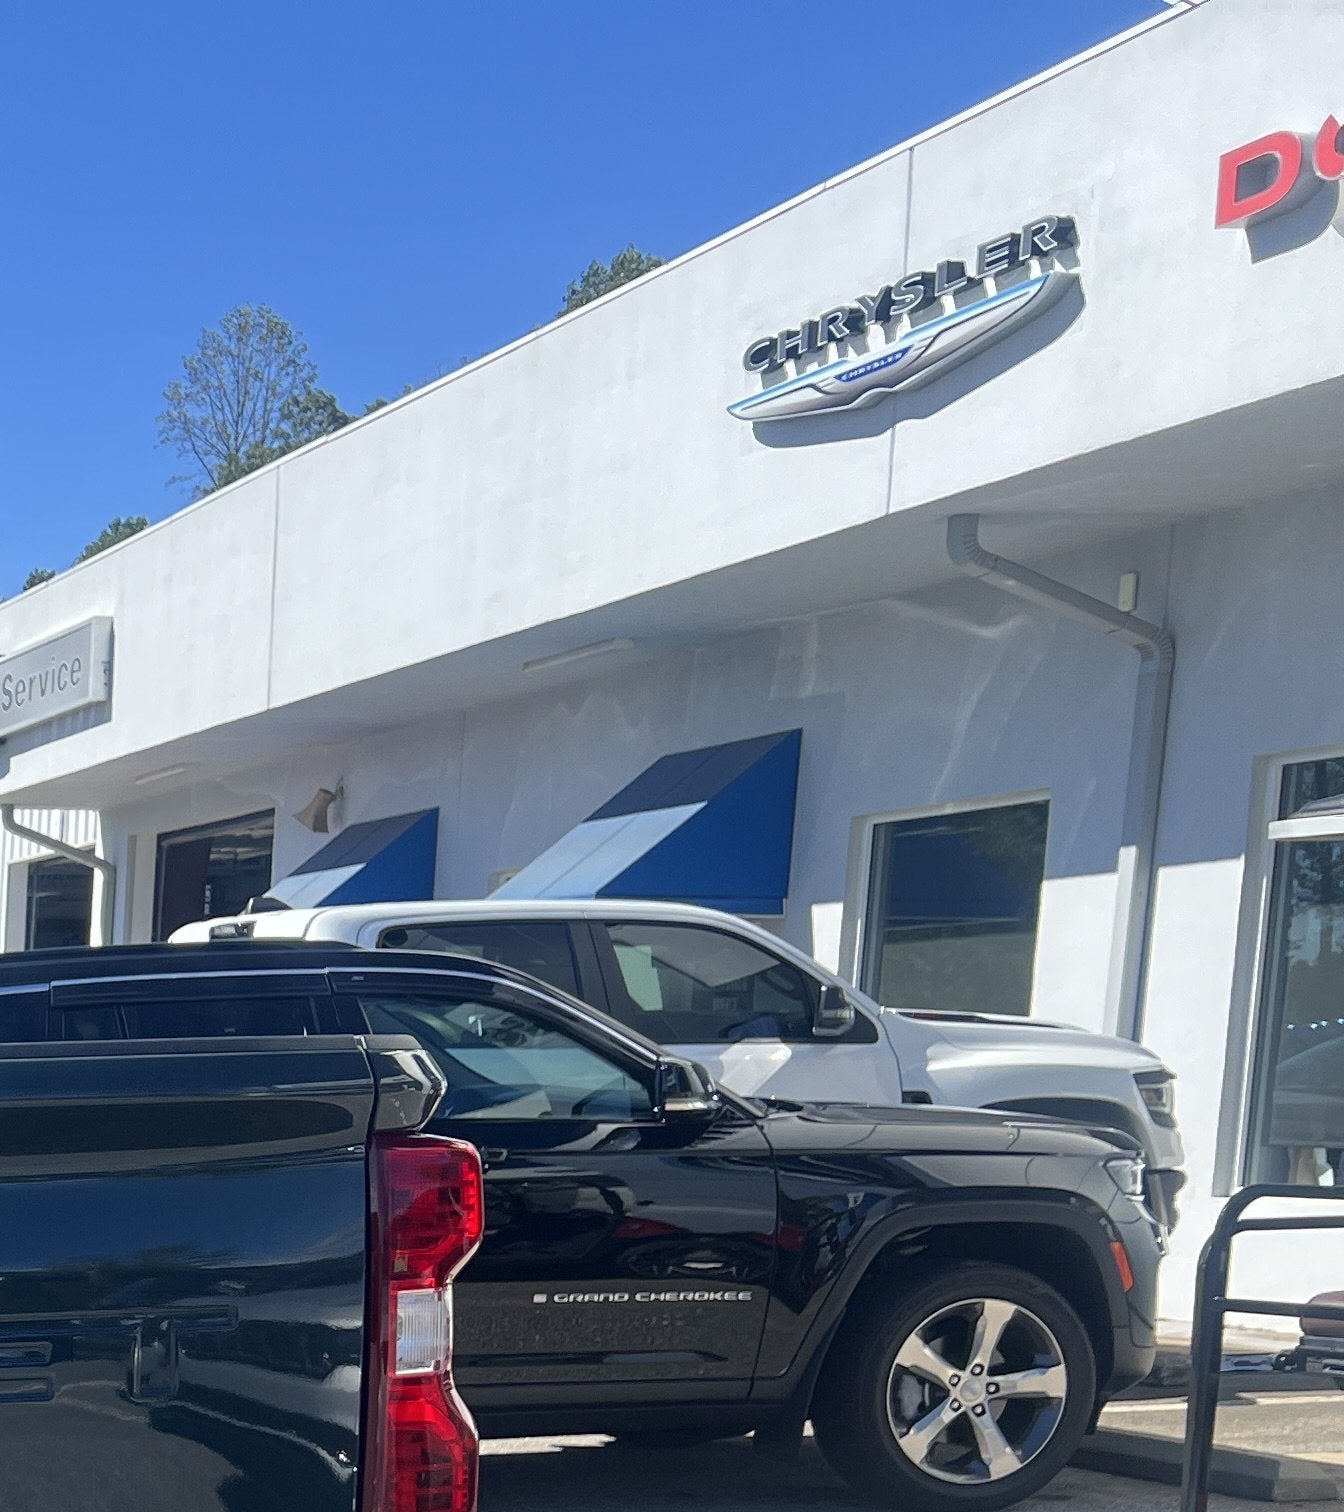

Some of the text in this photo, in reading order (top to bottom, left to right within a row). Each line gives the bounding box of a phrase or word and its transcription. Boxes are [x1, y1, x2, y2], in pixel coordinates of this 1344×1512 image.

[743, 214, 1074, 374] CHRYSLER
[1, 656, 82, 712] Service
[553, 1291, 753, 1303] GRAND CHEROKEE
